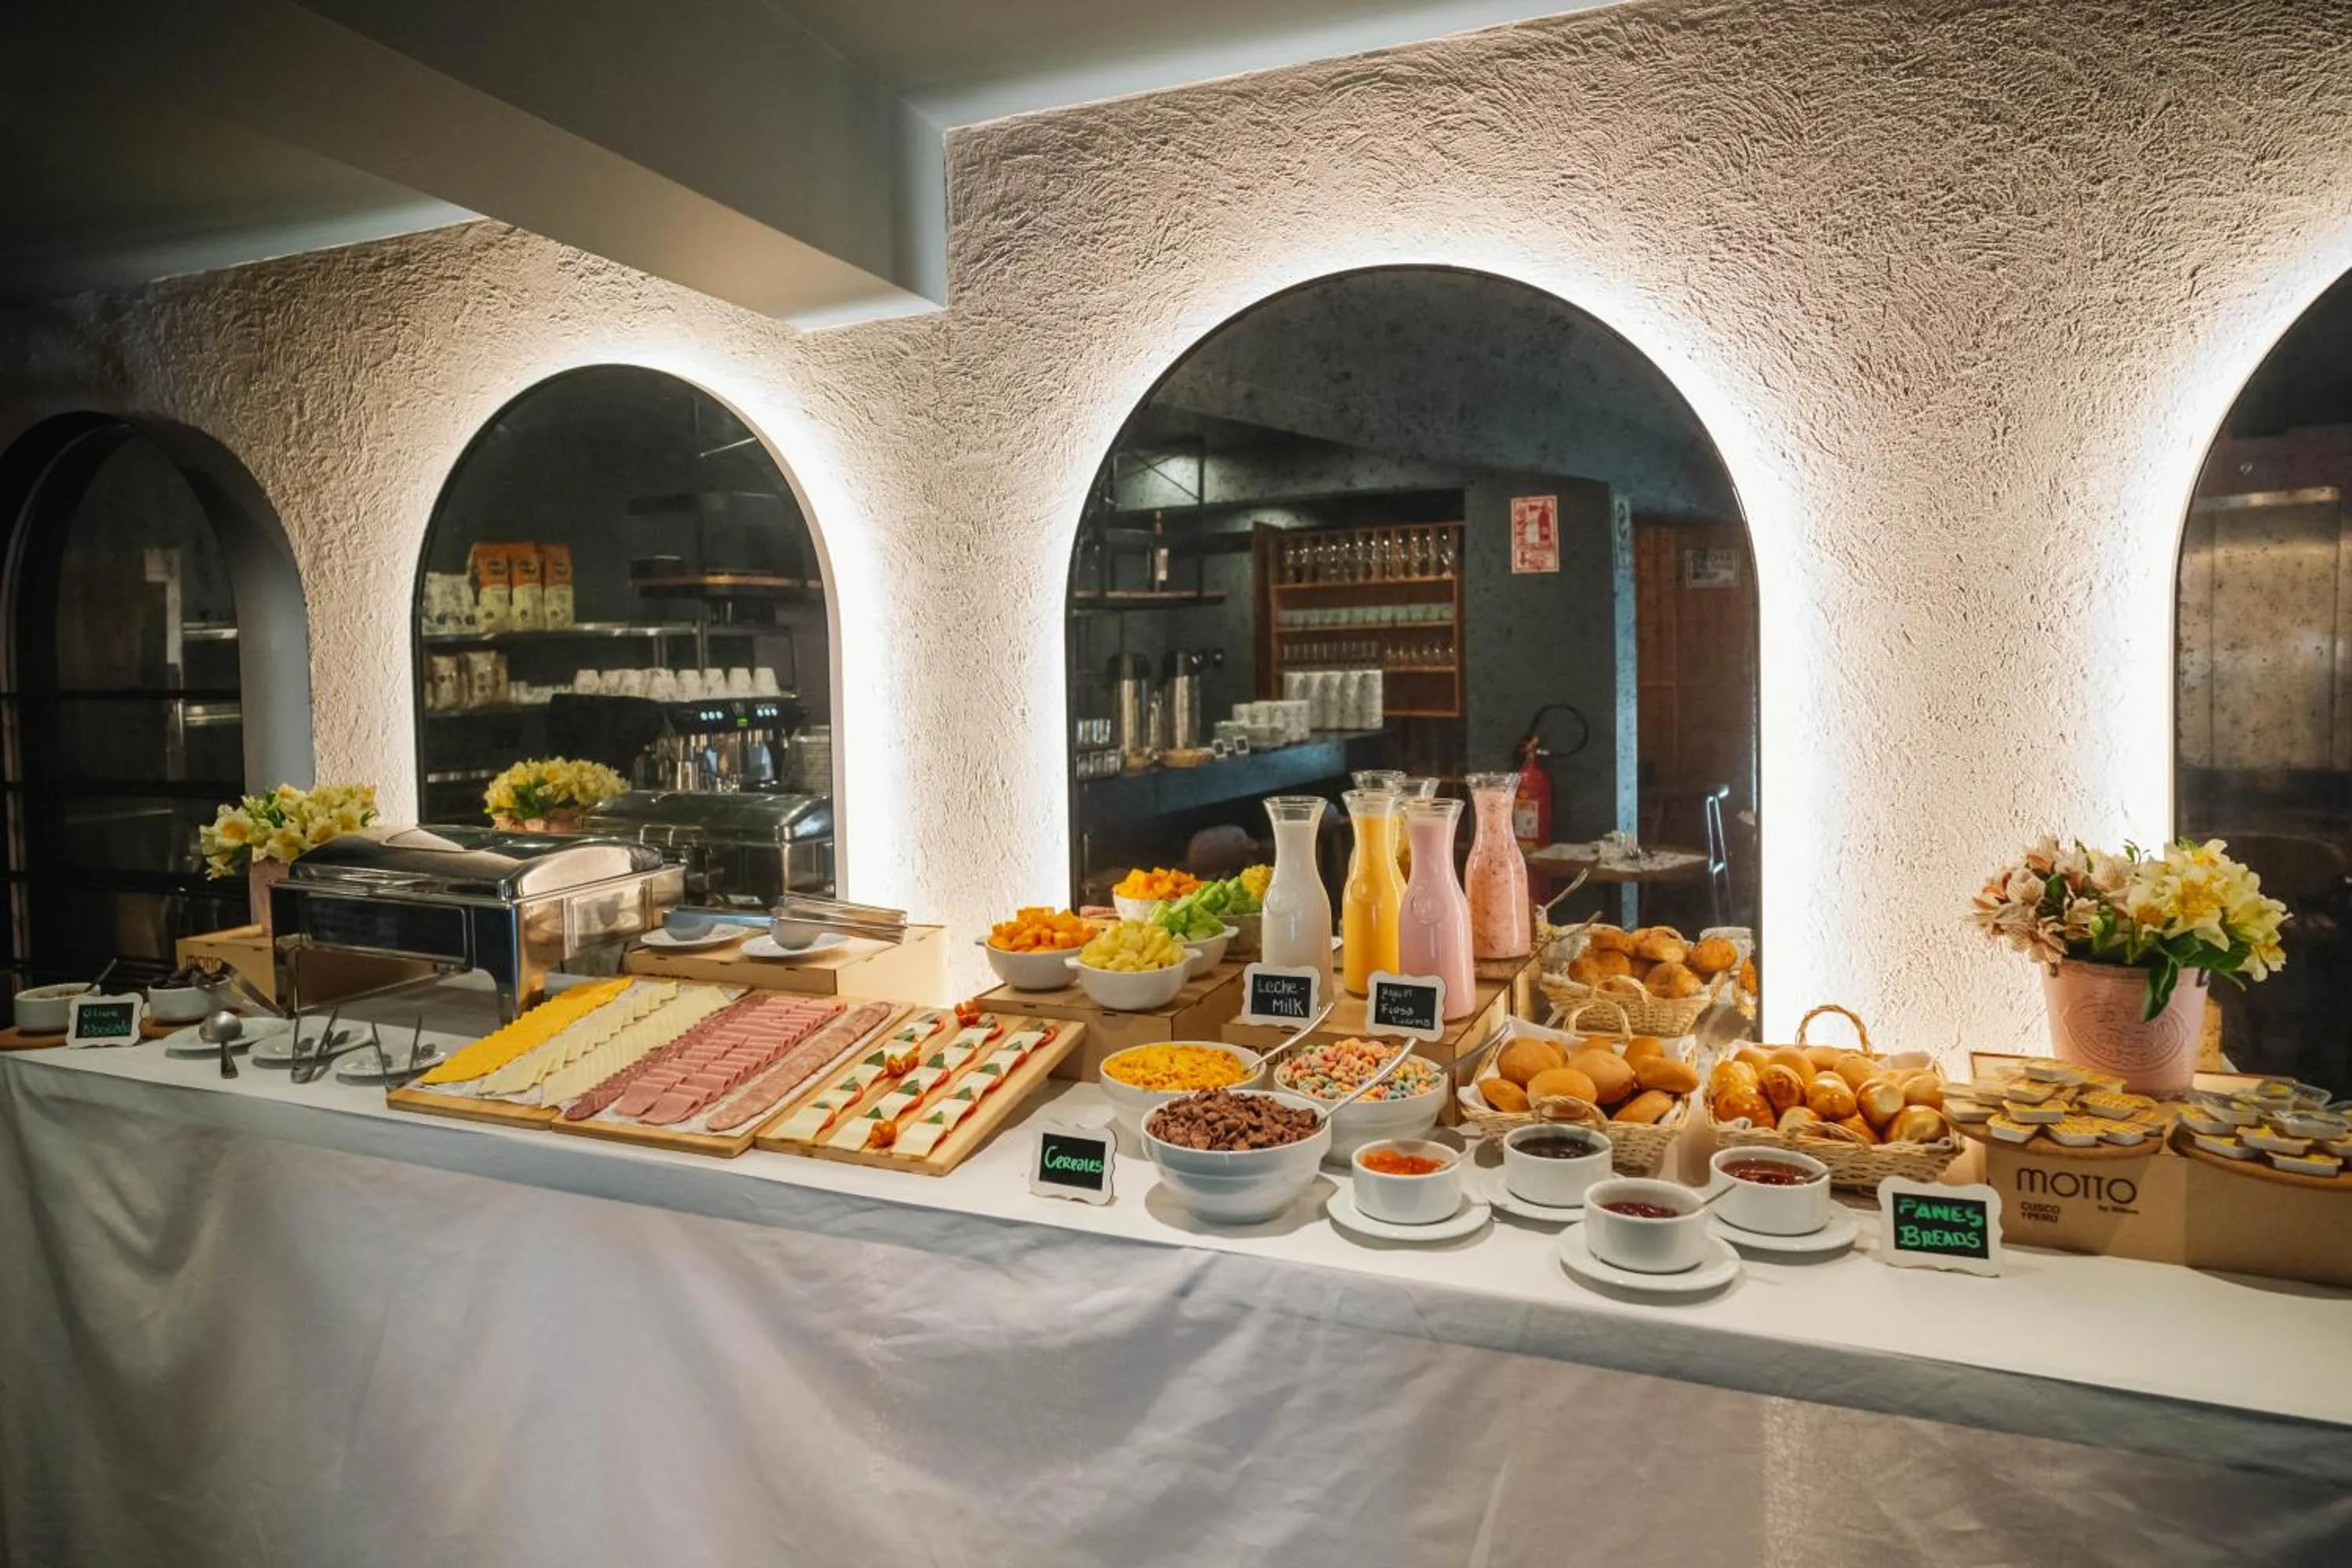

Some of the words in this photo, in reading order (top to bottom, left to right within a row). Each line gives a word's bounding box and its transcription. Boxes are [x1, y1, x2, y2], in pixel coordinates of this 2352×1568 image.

[1258, 978, 1298, 995] Leche
[1898, 1198, 1983, 1228] PANES
[2020, 1201, 2060, 1214] CUSCO
[1899, 1225, 1981, 1249] BREADS
